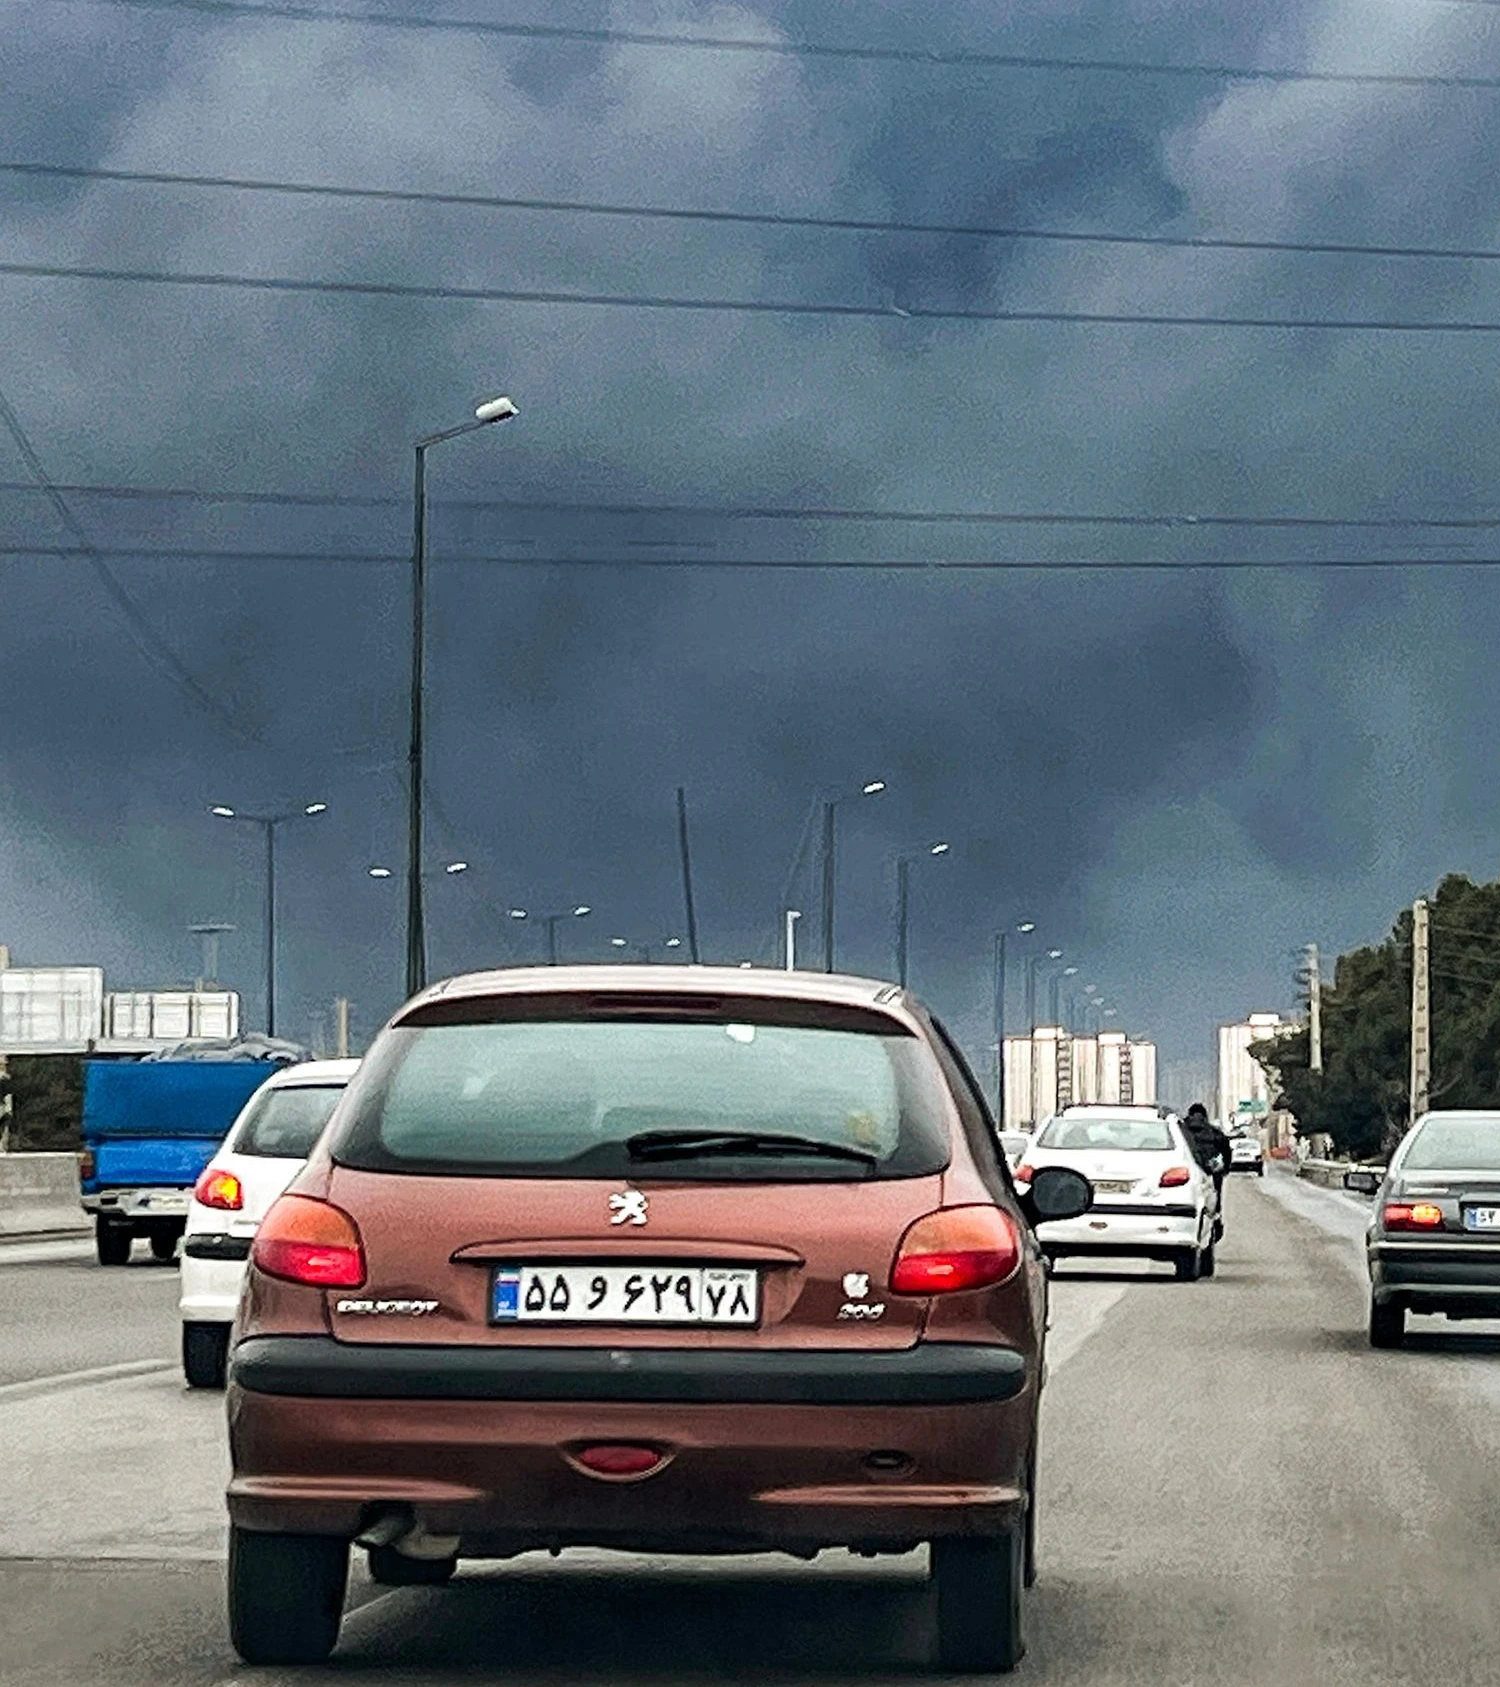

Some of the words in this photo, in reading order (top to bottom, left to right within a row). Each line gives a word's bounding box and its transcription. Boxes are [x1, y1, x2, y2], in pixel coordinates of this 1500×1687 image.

[524, 1274, 570, 1312] ۵۵
[587, 1275, 608, 1310] و
[623, 1275, 696, 1313] ۶۲۹
[706, 1284, 749, 1316] ۷۸
